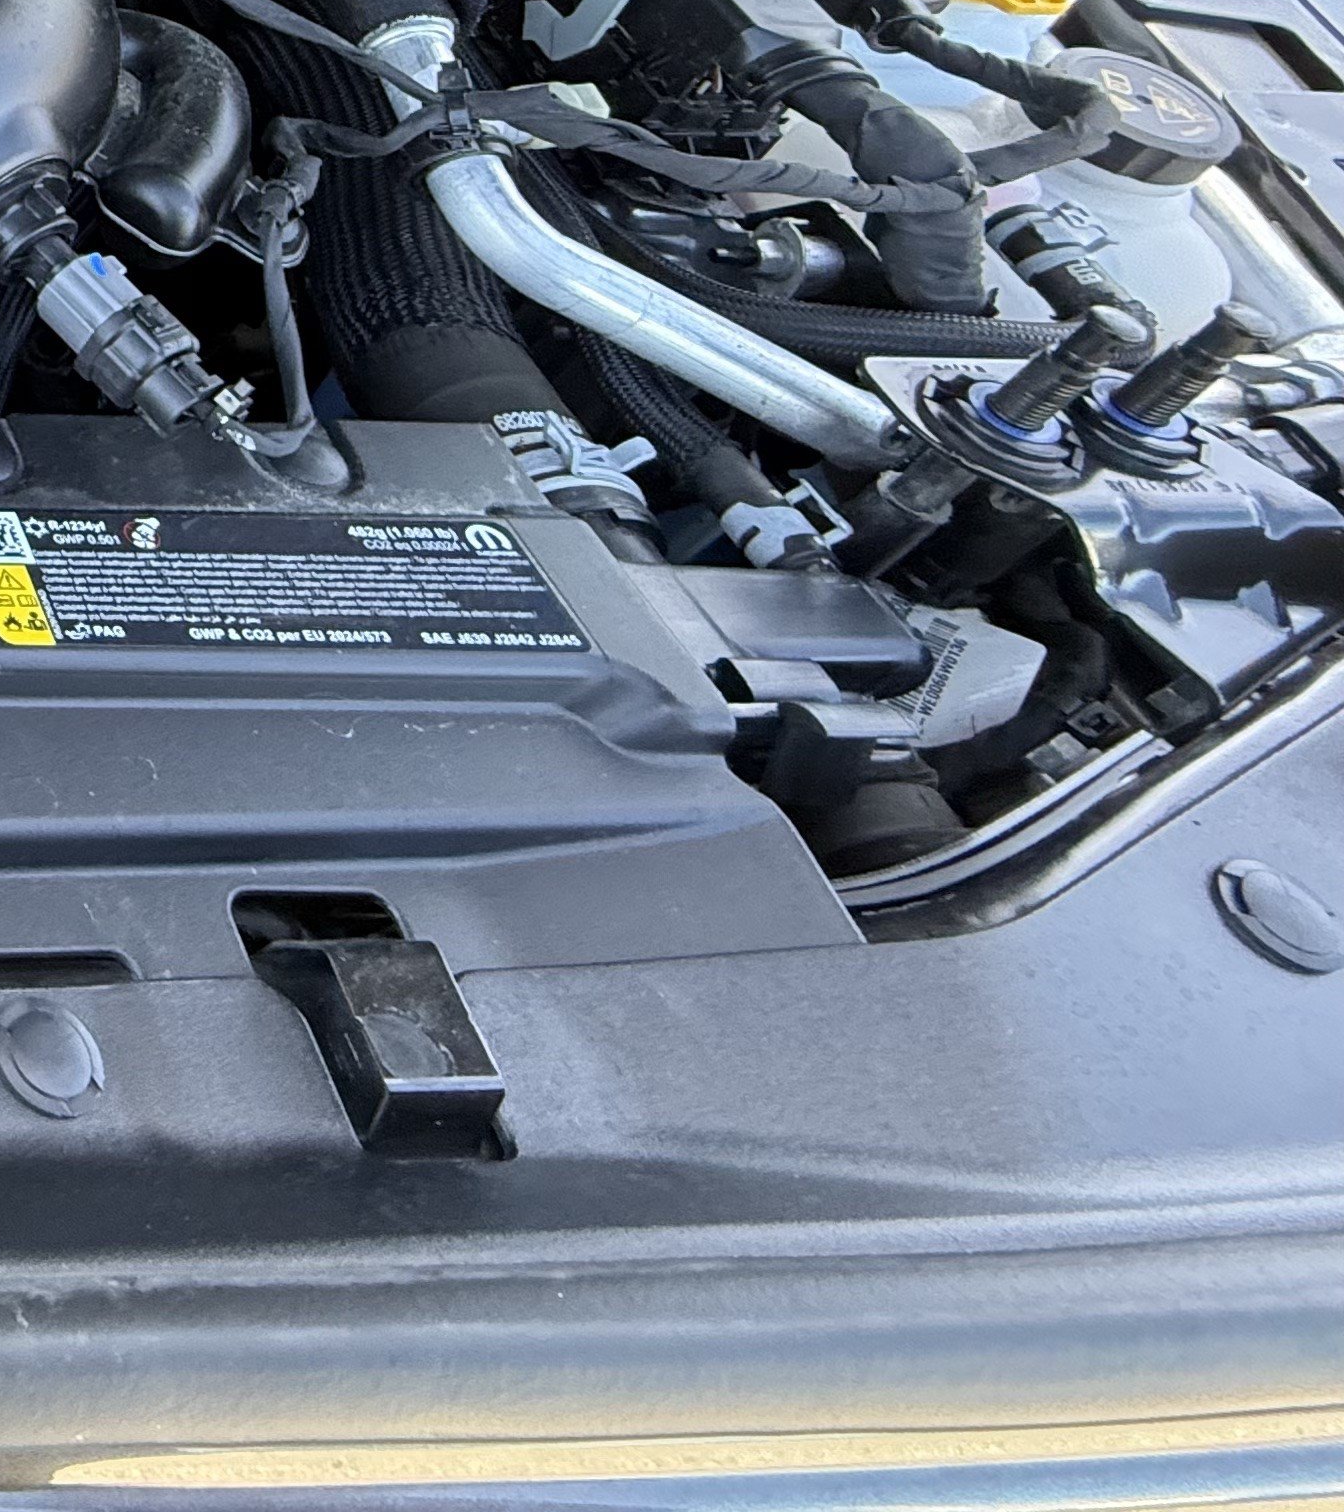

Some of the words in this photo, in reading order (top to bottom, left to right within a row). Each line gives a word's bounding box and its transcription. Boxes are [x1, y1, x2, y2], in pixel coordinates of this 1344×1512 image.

[52, 533, 84, 545] GWP
[86, 534, 121, 546] 0.501
[434, 526, 459, 542] lb)
[363, 539, 394, 551] CO2
[93, 624, 127, 638] PAG
[189, 628, 226, 641] GWP
[227, 628, 242, 641] &
[242, 628, 275, 642] CO2
[277, 630, 302, 644] per
[301, 630, 325, 642] EU
[420, 632, 455, 645] SAE
[456, 632, 493, 645] J639
